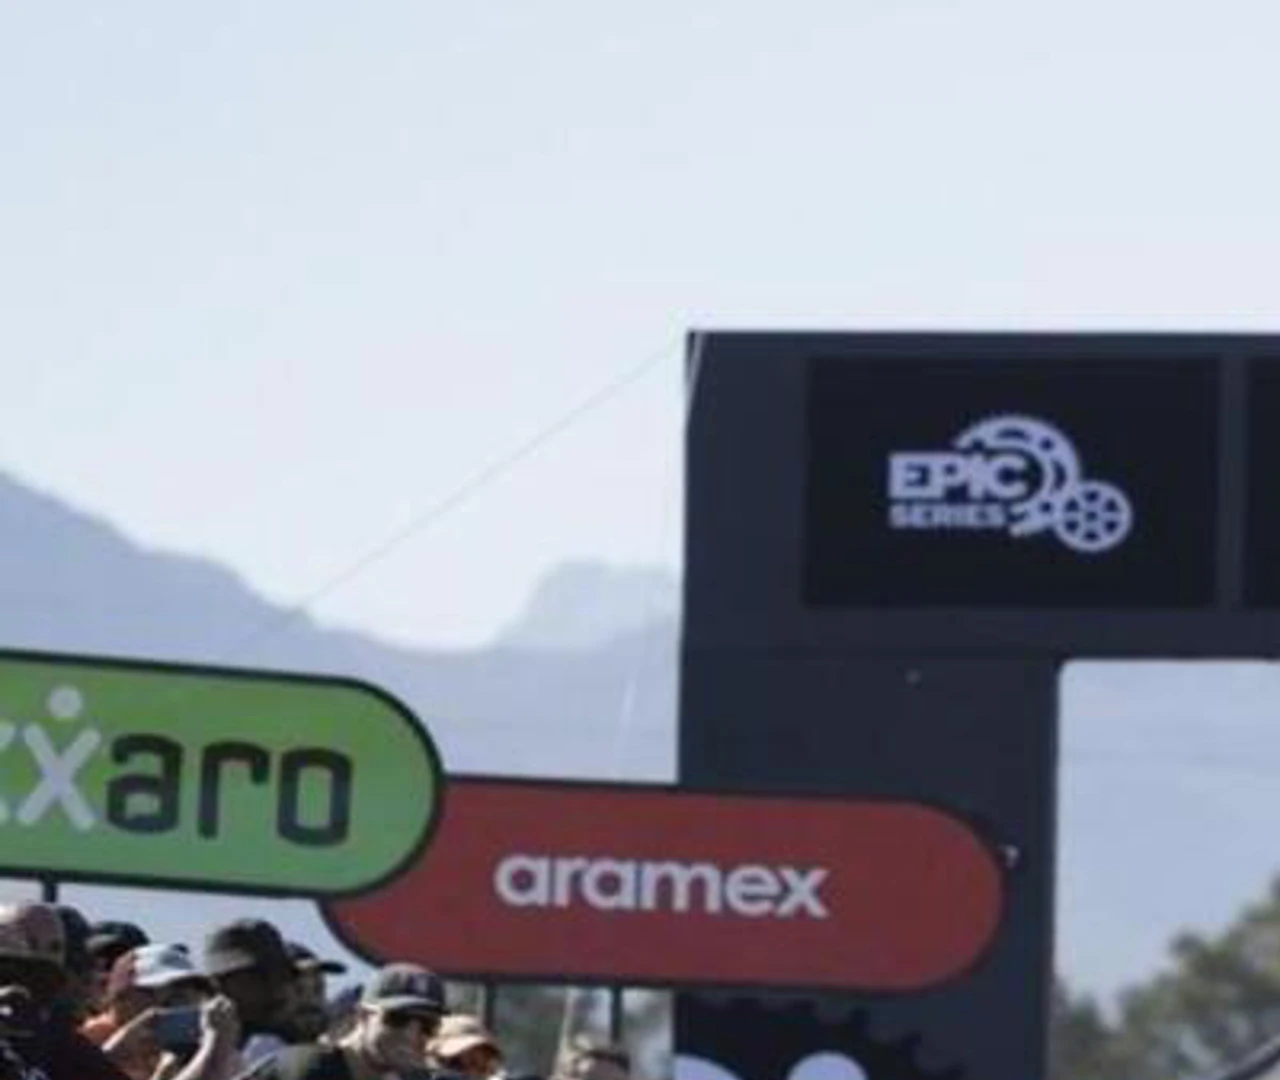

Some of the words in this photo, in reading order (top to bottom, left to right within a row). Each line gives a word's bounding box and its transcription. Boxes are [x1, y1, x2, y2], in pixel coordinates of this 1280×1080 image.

[889, 452, 1028, 499] EPIC
[889, 504, 1007, 528] SERIES
[0, 687, 354, 847] xaro
[494, 856, 829, 918] aramex
